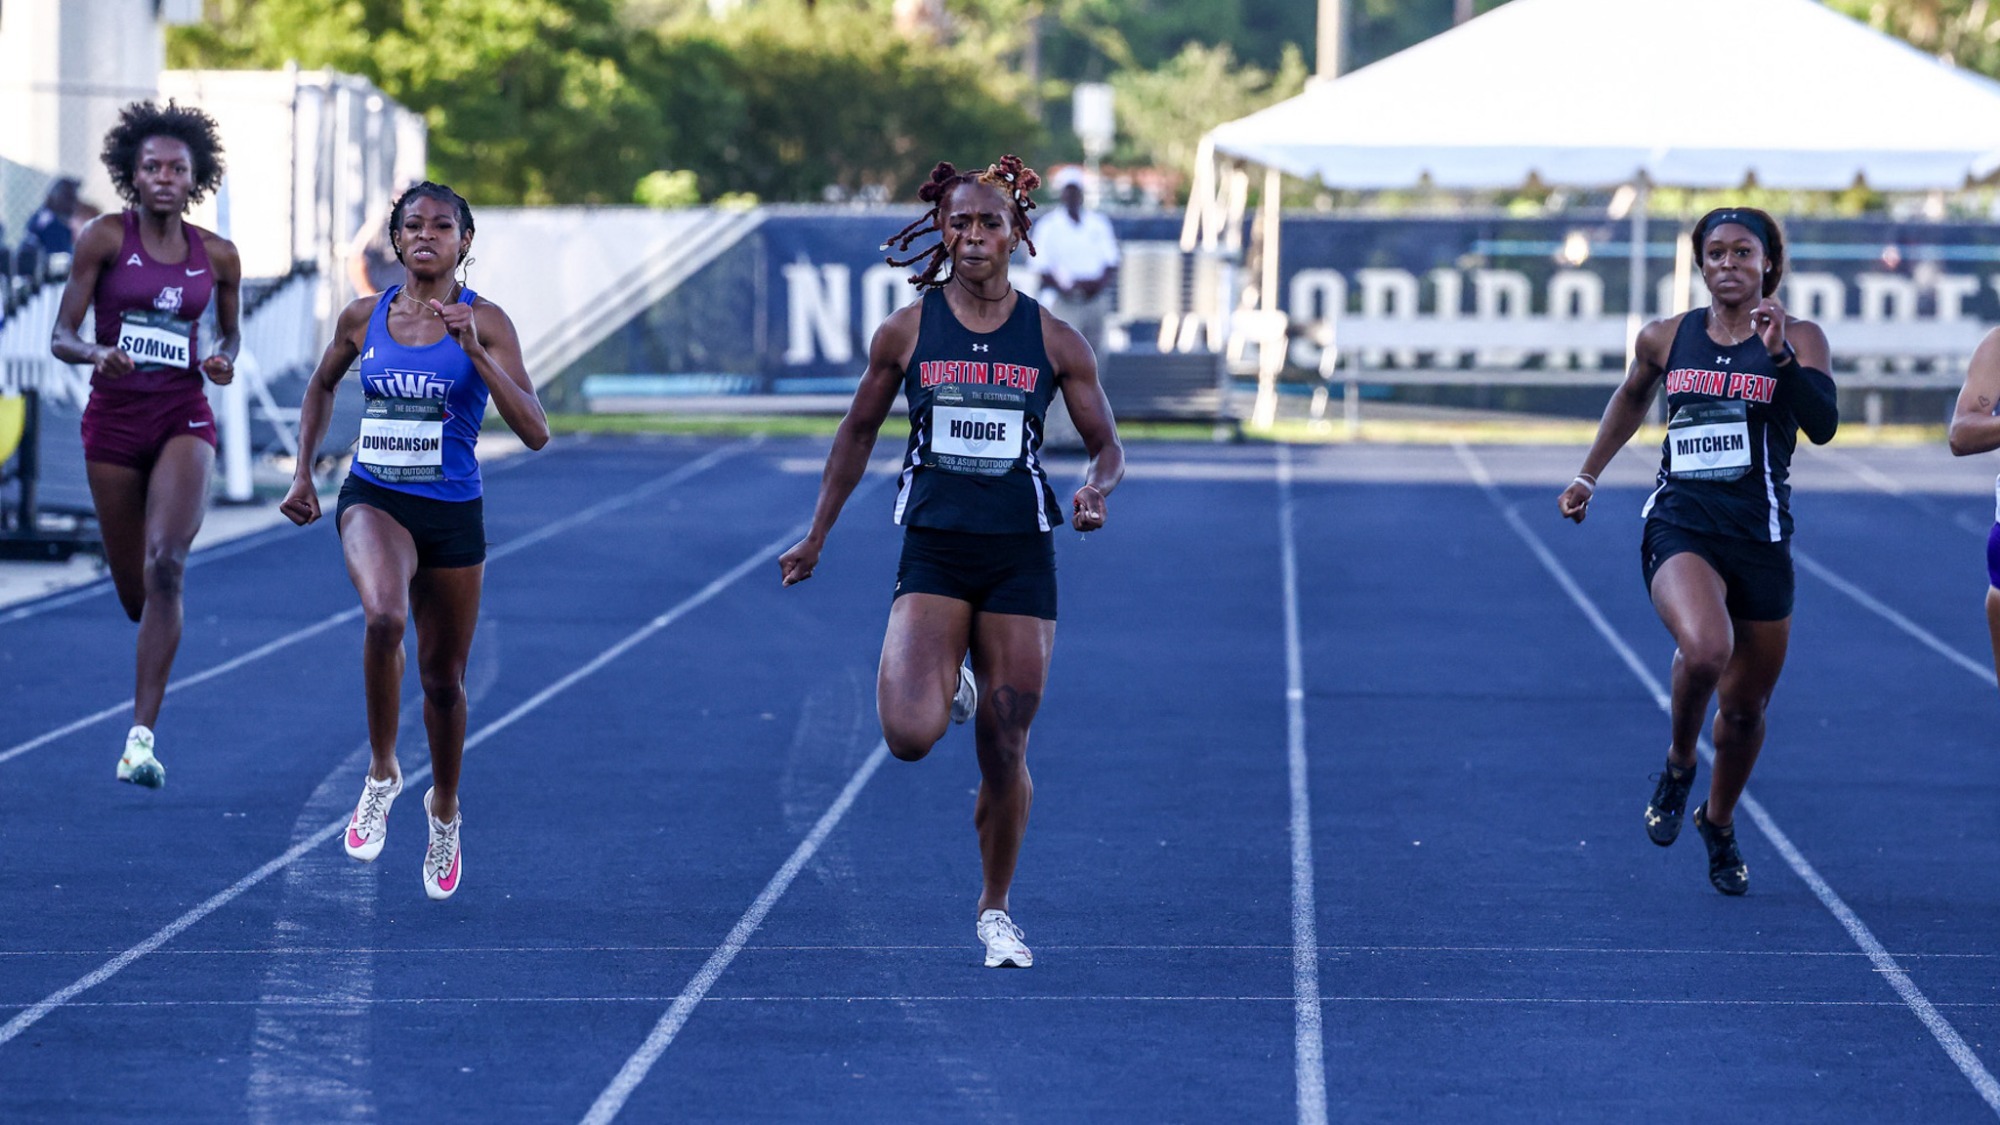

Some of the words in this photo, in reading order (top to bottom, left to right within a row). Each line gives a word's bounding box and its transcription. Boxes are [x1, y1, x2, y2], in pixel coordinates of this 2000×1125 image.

[1289, 267, 1604, 368] ORIDA
[121, 335, 186, 362] SOMWE
[373, 372, 445, 399] UWG
[920, 360, 988, 388] AUSTIN
[993, 362, 1039, 393] PEAY
[1666, 368, 1727, 396] AUSTIN
[1727, 372, 1777, 404] PEAY
[971, 391, 982, 400] THE
[950, 419, 1006, 441] HODGE
[362, 435, 439, 452] DUNCANSON
[1677, 434, 1744, 456] MITCHEM
[402, 467, 436, 475] OUTDOOR
[957, 458, 977, 467] ASUN
